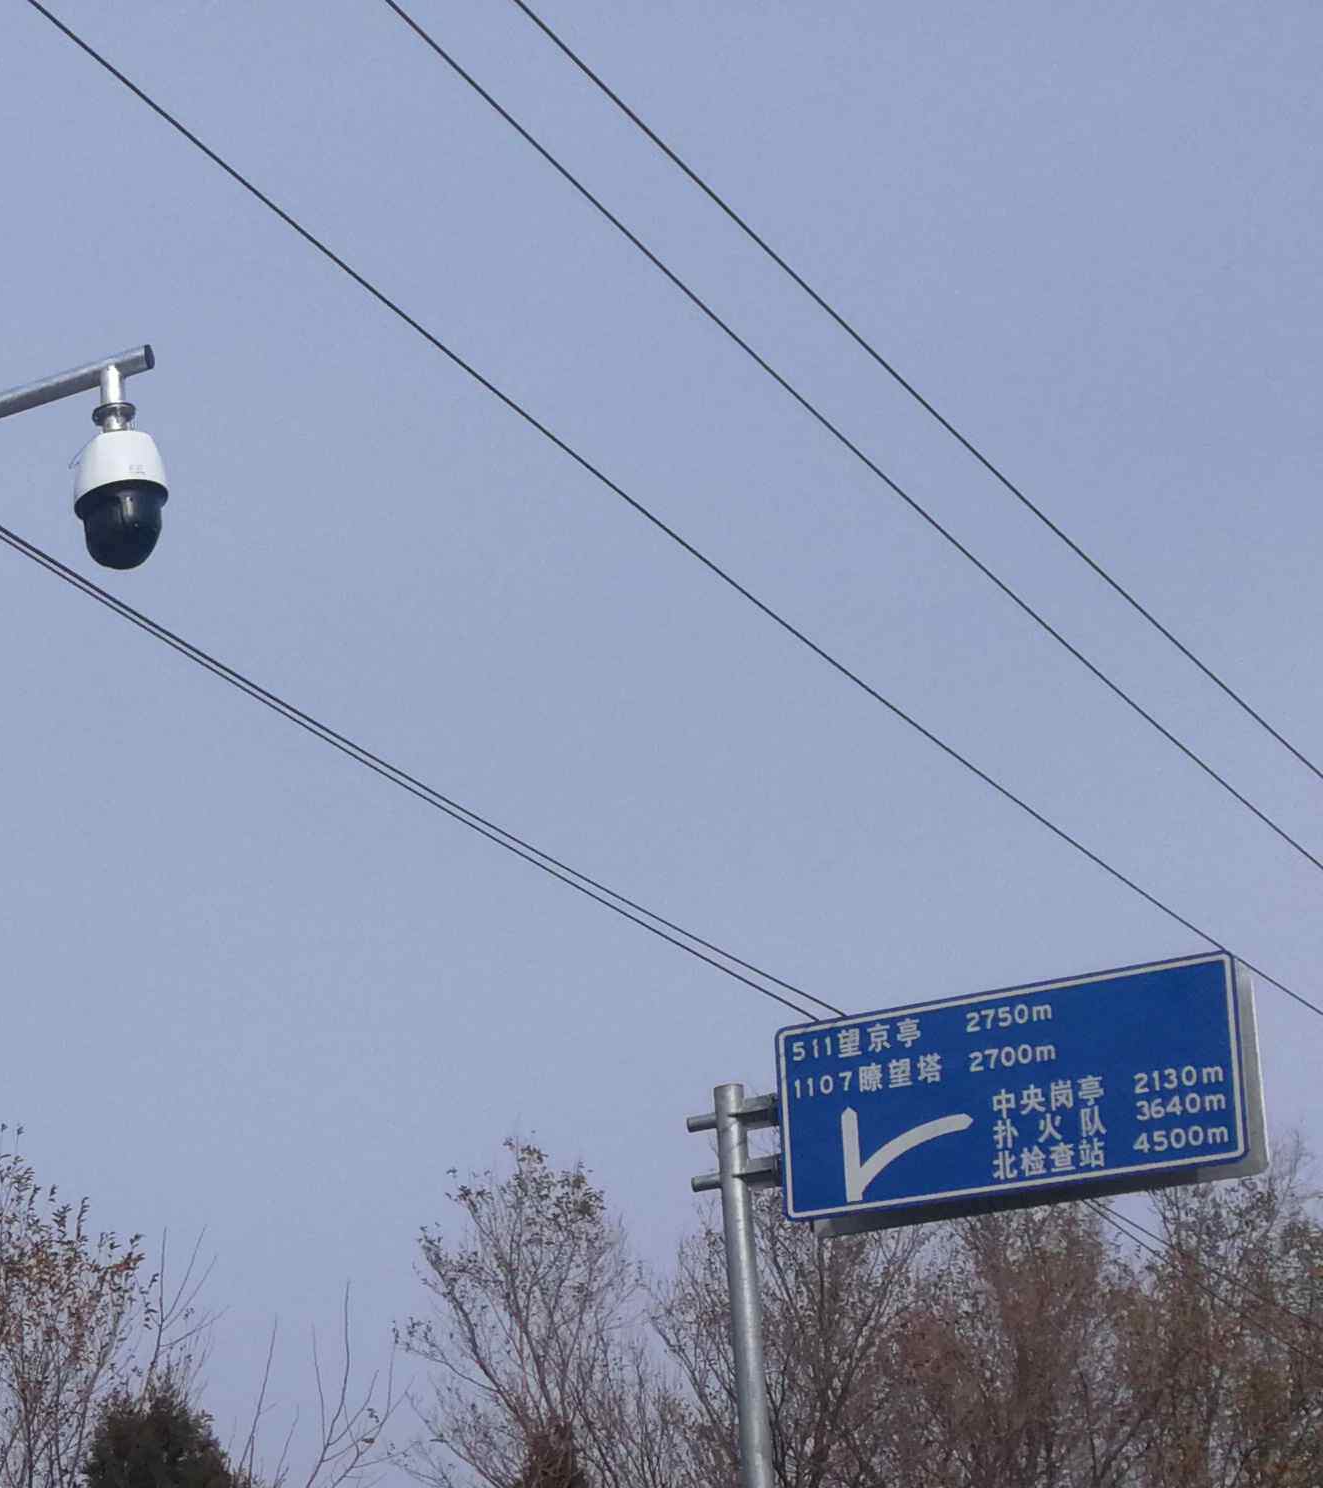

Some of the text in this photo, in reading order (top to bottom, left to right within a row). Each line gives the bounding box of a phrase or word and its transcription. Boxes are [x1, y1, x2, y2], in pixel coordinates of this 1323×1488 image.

[966, 1004, 1053, 1033] 2750m
[969, 1044, 1056, 1072] 2700m
[992, 1066, 1223, 1118] 中央岗亭 2130m
[1136, 1093, 1226, 1121] 3640m
[993, 1125, 1229, 1180] 北检查站 4500m
